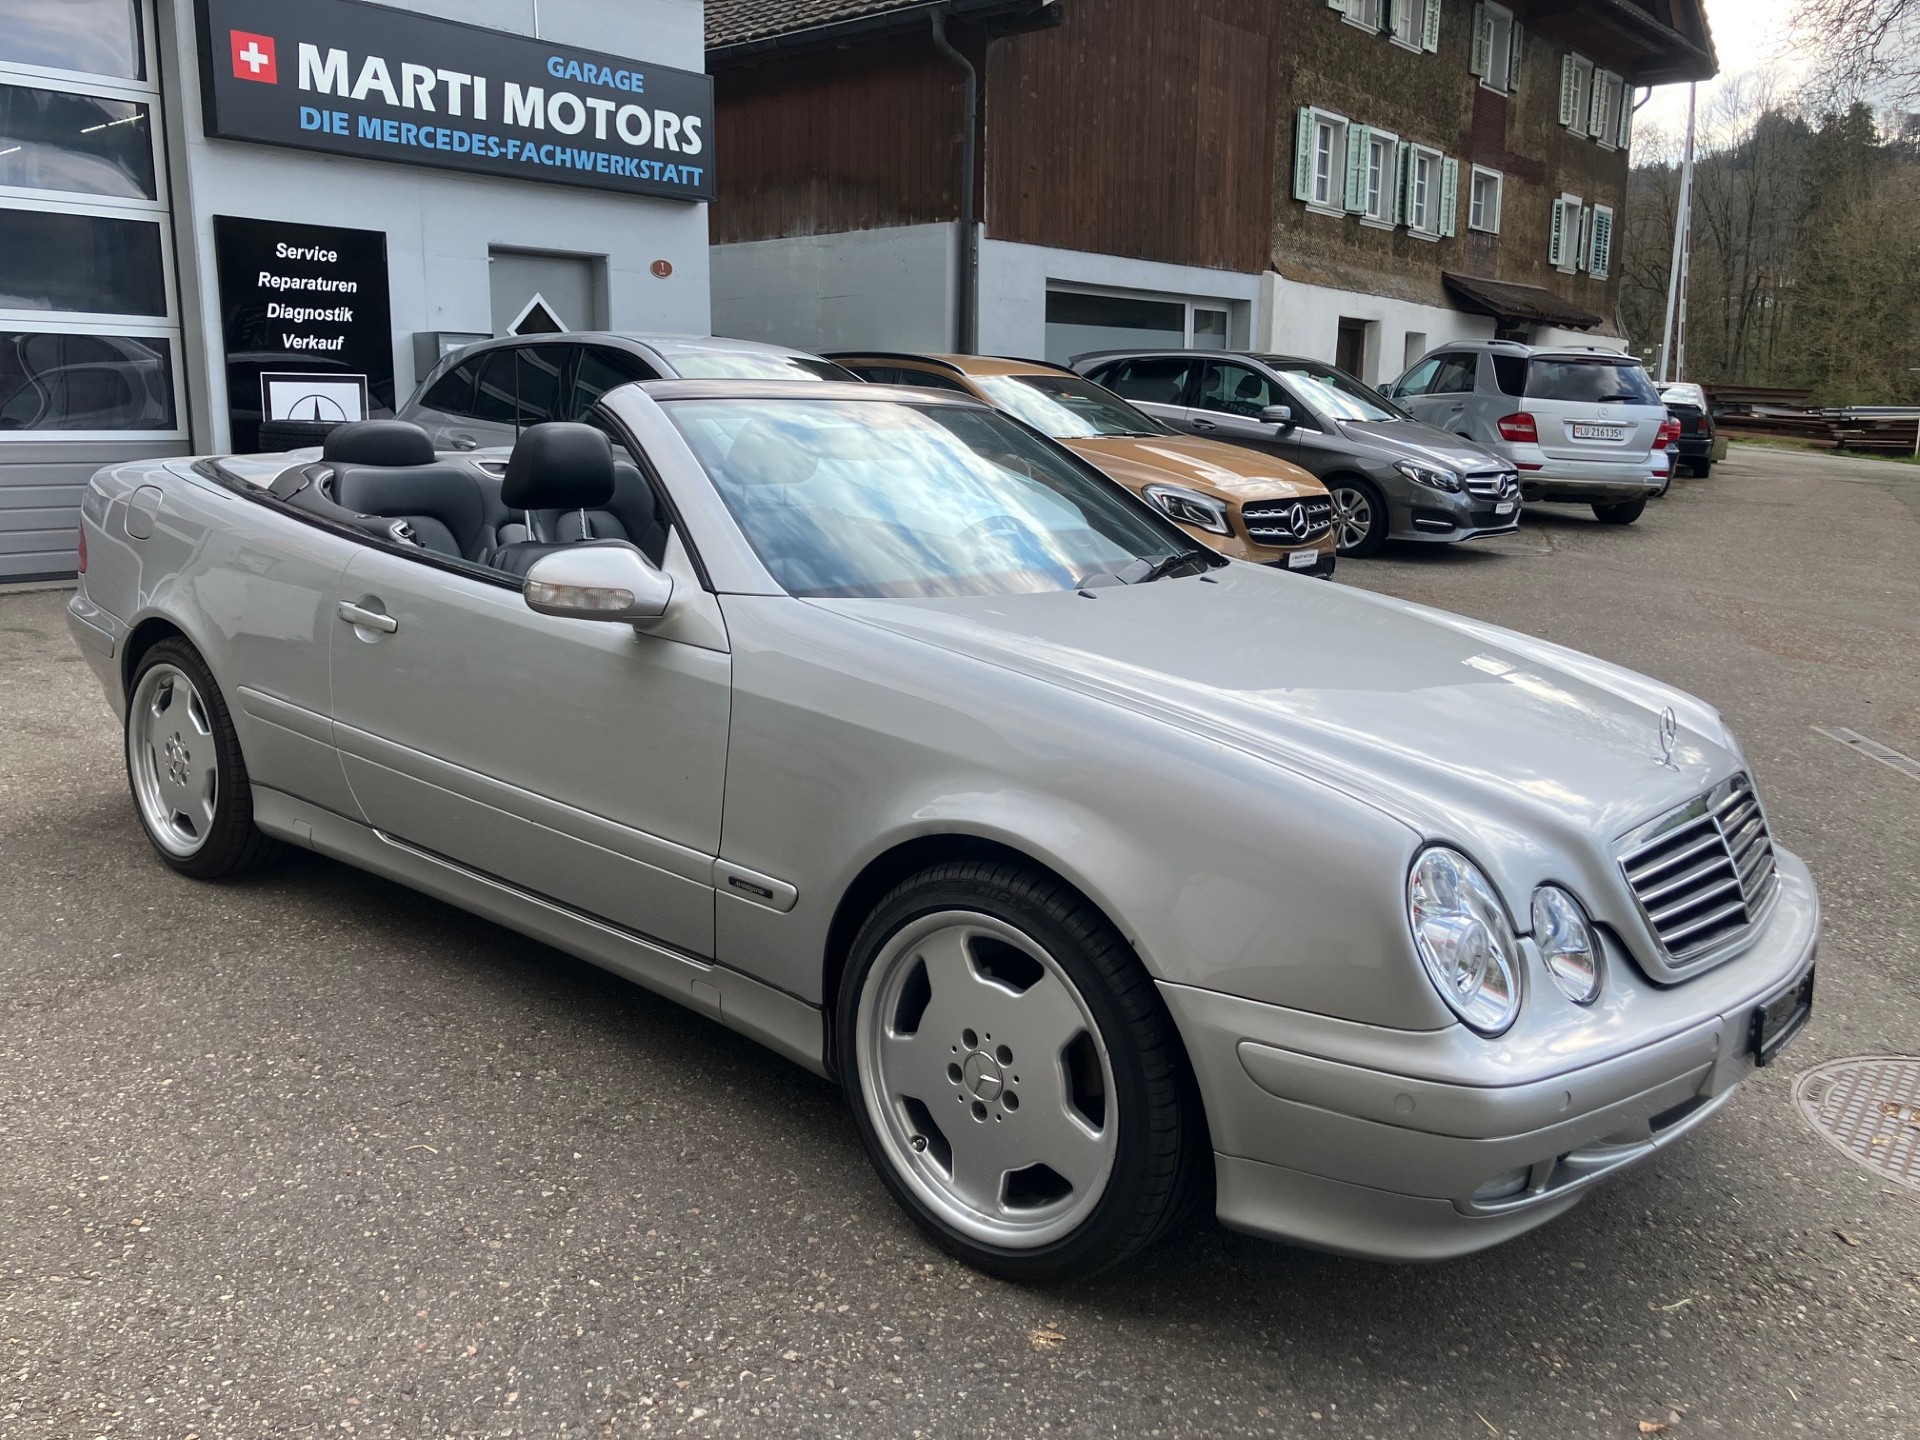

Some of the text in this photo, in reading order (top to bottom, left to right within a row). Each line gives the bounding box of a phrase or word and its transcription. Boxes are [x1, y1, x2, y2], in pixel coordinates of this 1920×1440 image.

[547, 55, 644, 94] GARAGE
[298, 42, 703, 155] MARTI MOTORS
[299, 105, 704, 187] DIE MERCEDES-FACHWERKSTATT
[275, 242, 338, 263] Service
[258, 271, 358, 293] Reparaturen
[266, 302, 354, 324] Diagnostik
[282, 333, 345, 351] Verkauf
[1580, 426, 1590, 436] LU
